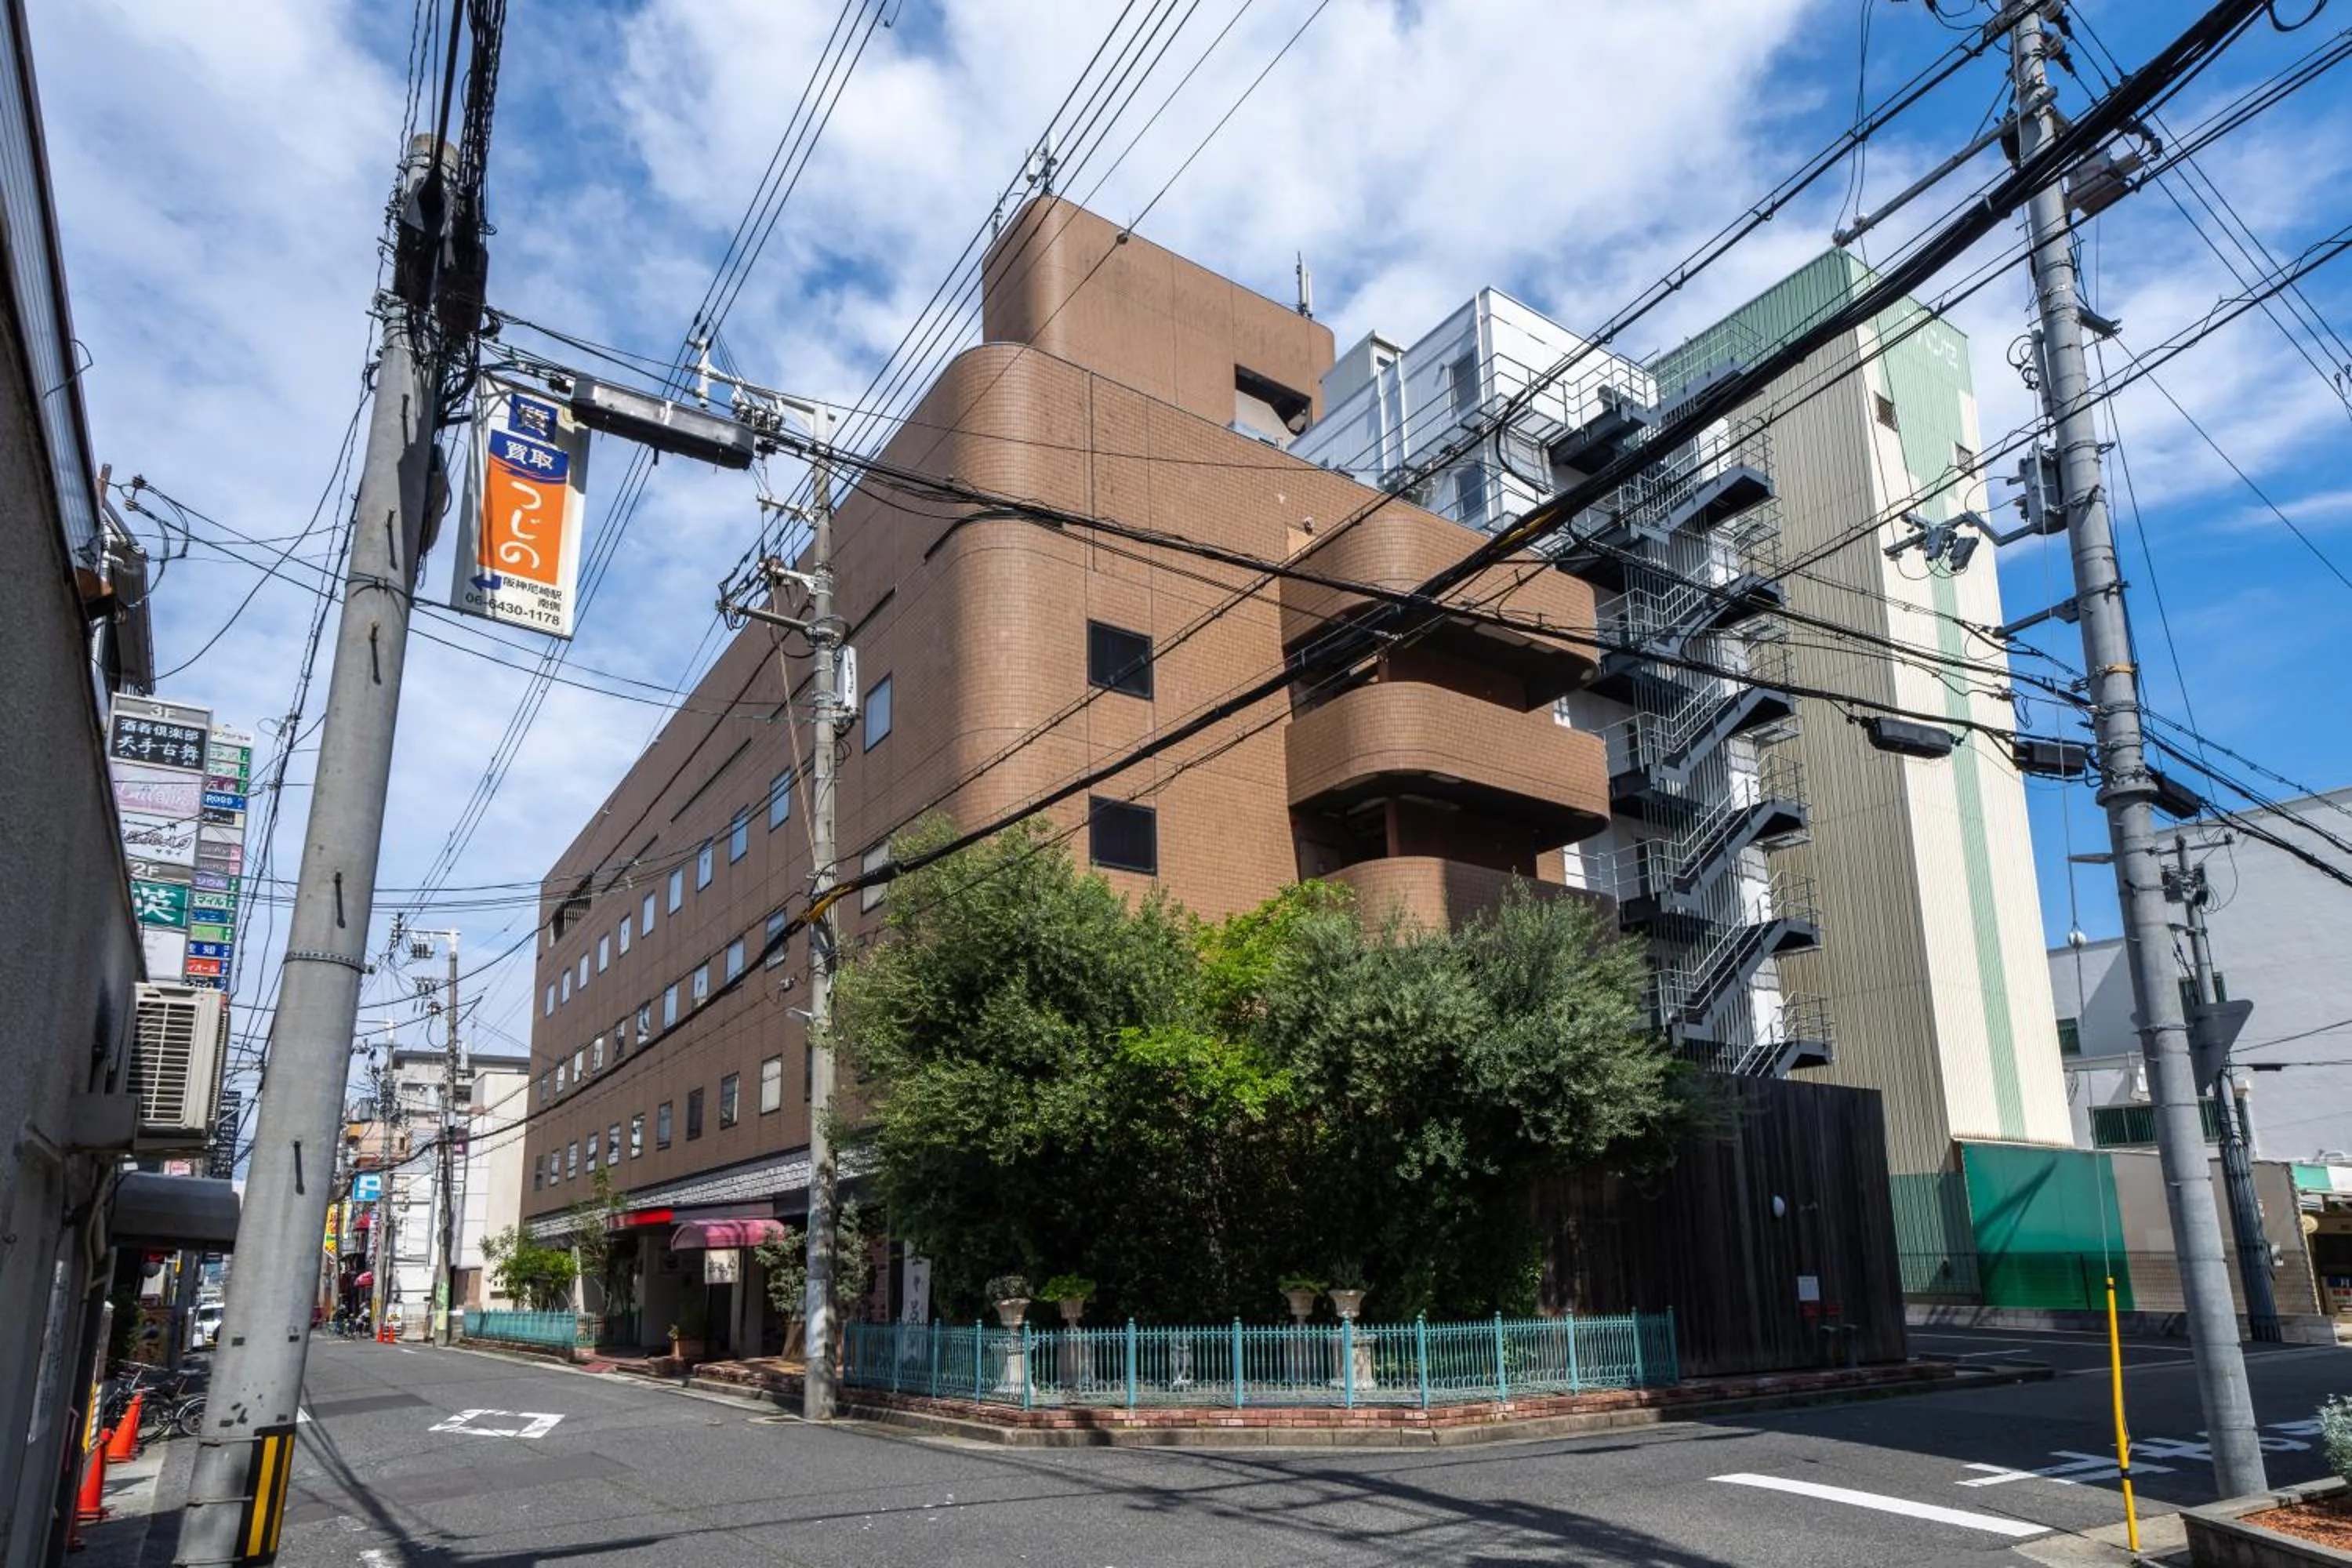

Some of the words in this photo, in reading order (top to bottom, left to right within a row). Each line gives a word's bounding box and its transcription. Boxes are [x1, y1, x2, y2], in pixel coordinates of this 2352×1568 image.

[504, 440, 554, 470] 買取
[499, 481, 543, 569] つじの
[503, 576, 563, 601] 阪神尼崎駅
[465, 592, 561, 626] 06-6430-1178
[150, 703, 176, 719] 3F
[132, 862, 161, 877] 2F
[357, 1175, 381, 1199] P
